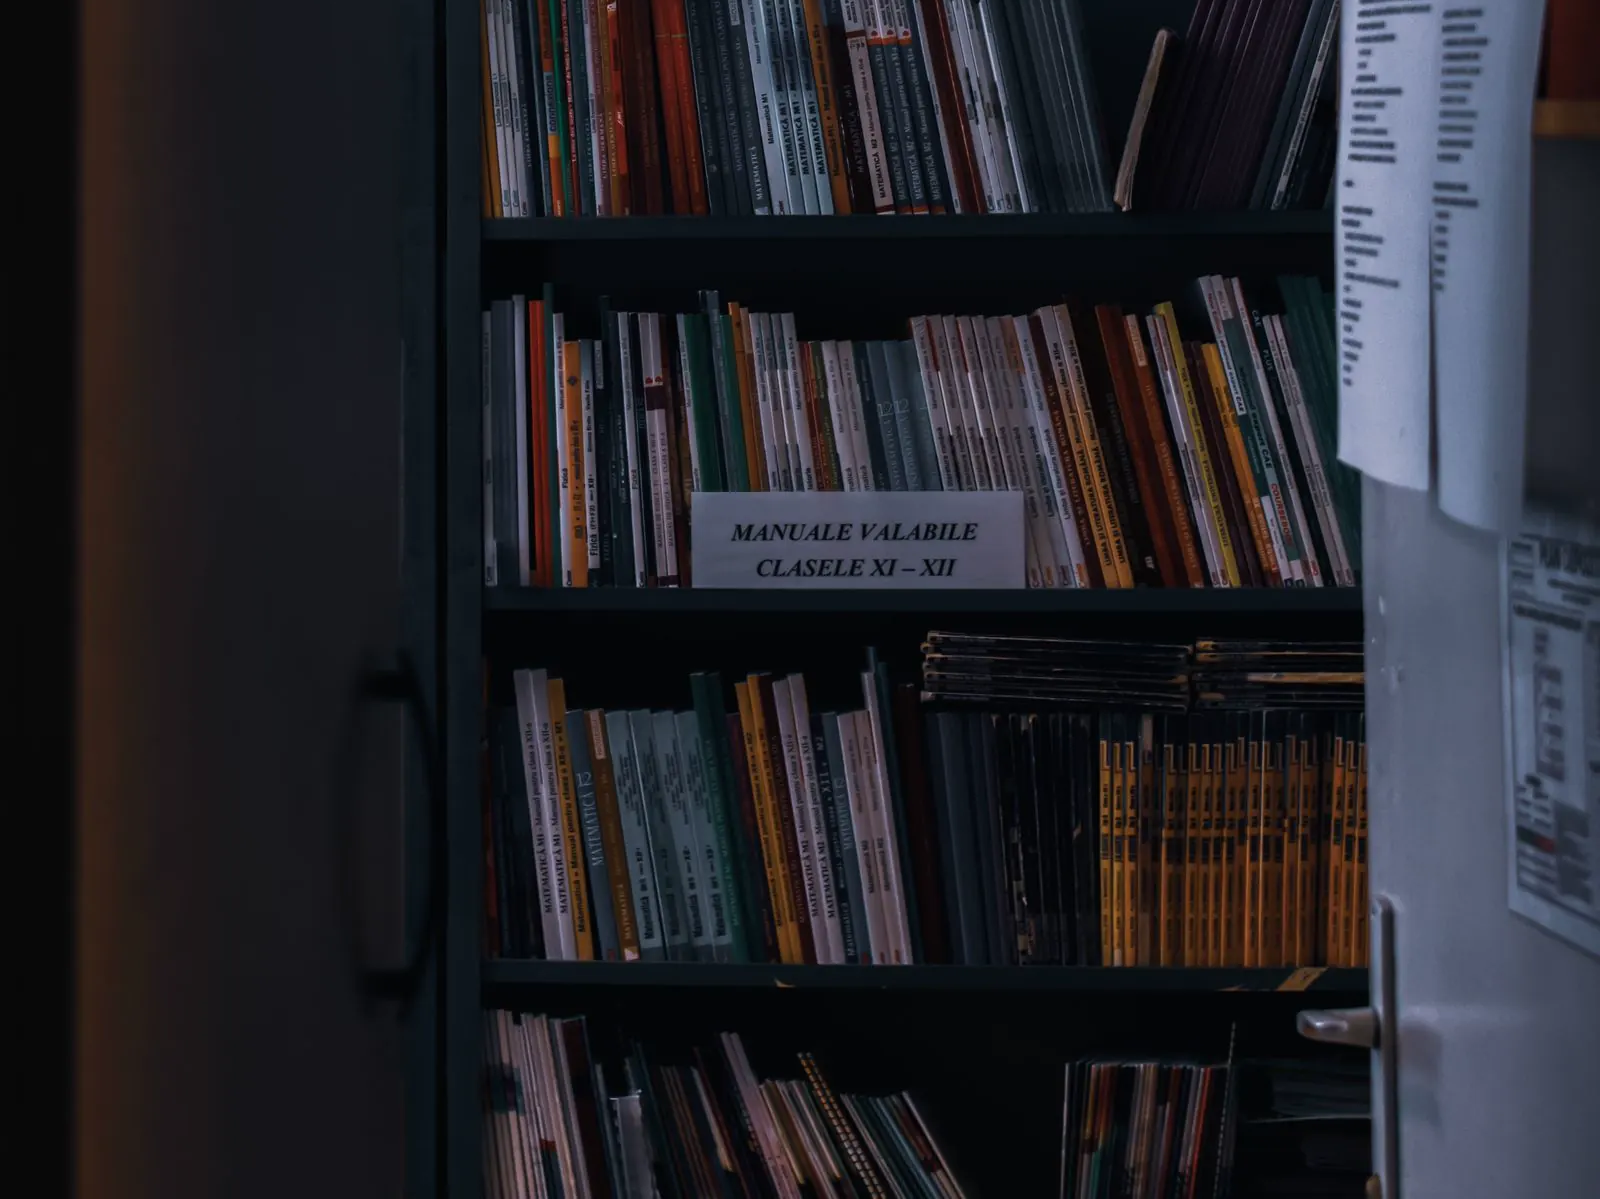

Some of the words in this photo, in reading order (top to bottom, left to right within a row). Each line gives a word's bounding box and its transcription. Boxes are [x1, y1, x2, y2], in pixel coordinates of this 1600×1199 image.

[778, 118, 797, 176] MATEMATICĂ
[792, 117, 810, 175] MATEMATICĂ
[808, 116, 826, 175] MATEMATICĂ
[731, 523, 852, 542] MANUALE
[860, 522, 978, 541] VALABILE
[756, 558, 865, 578] CLASELE
[870, 558, 897, 577] XI
[922, 558, 957, 577] XII
[579, 790, 605, 866] MATEMATICĂ
[537, 848, 552, 914] MATEMATICĂ
[553, 848, 569, 914] MATEMATICĂ
[802, 854, 820, 917] MATEMATICĂ
[818, 856, 836, 918] MATEMATICĂ
